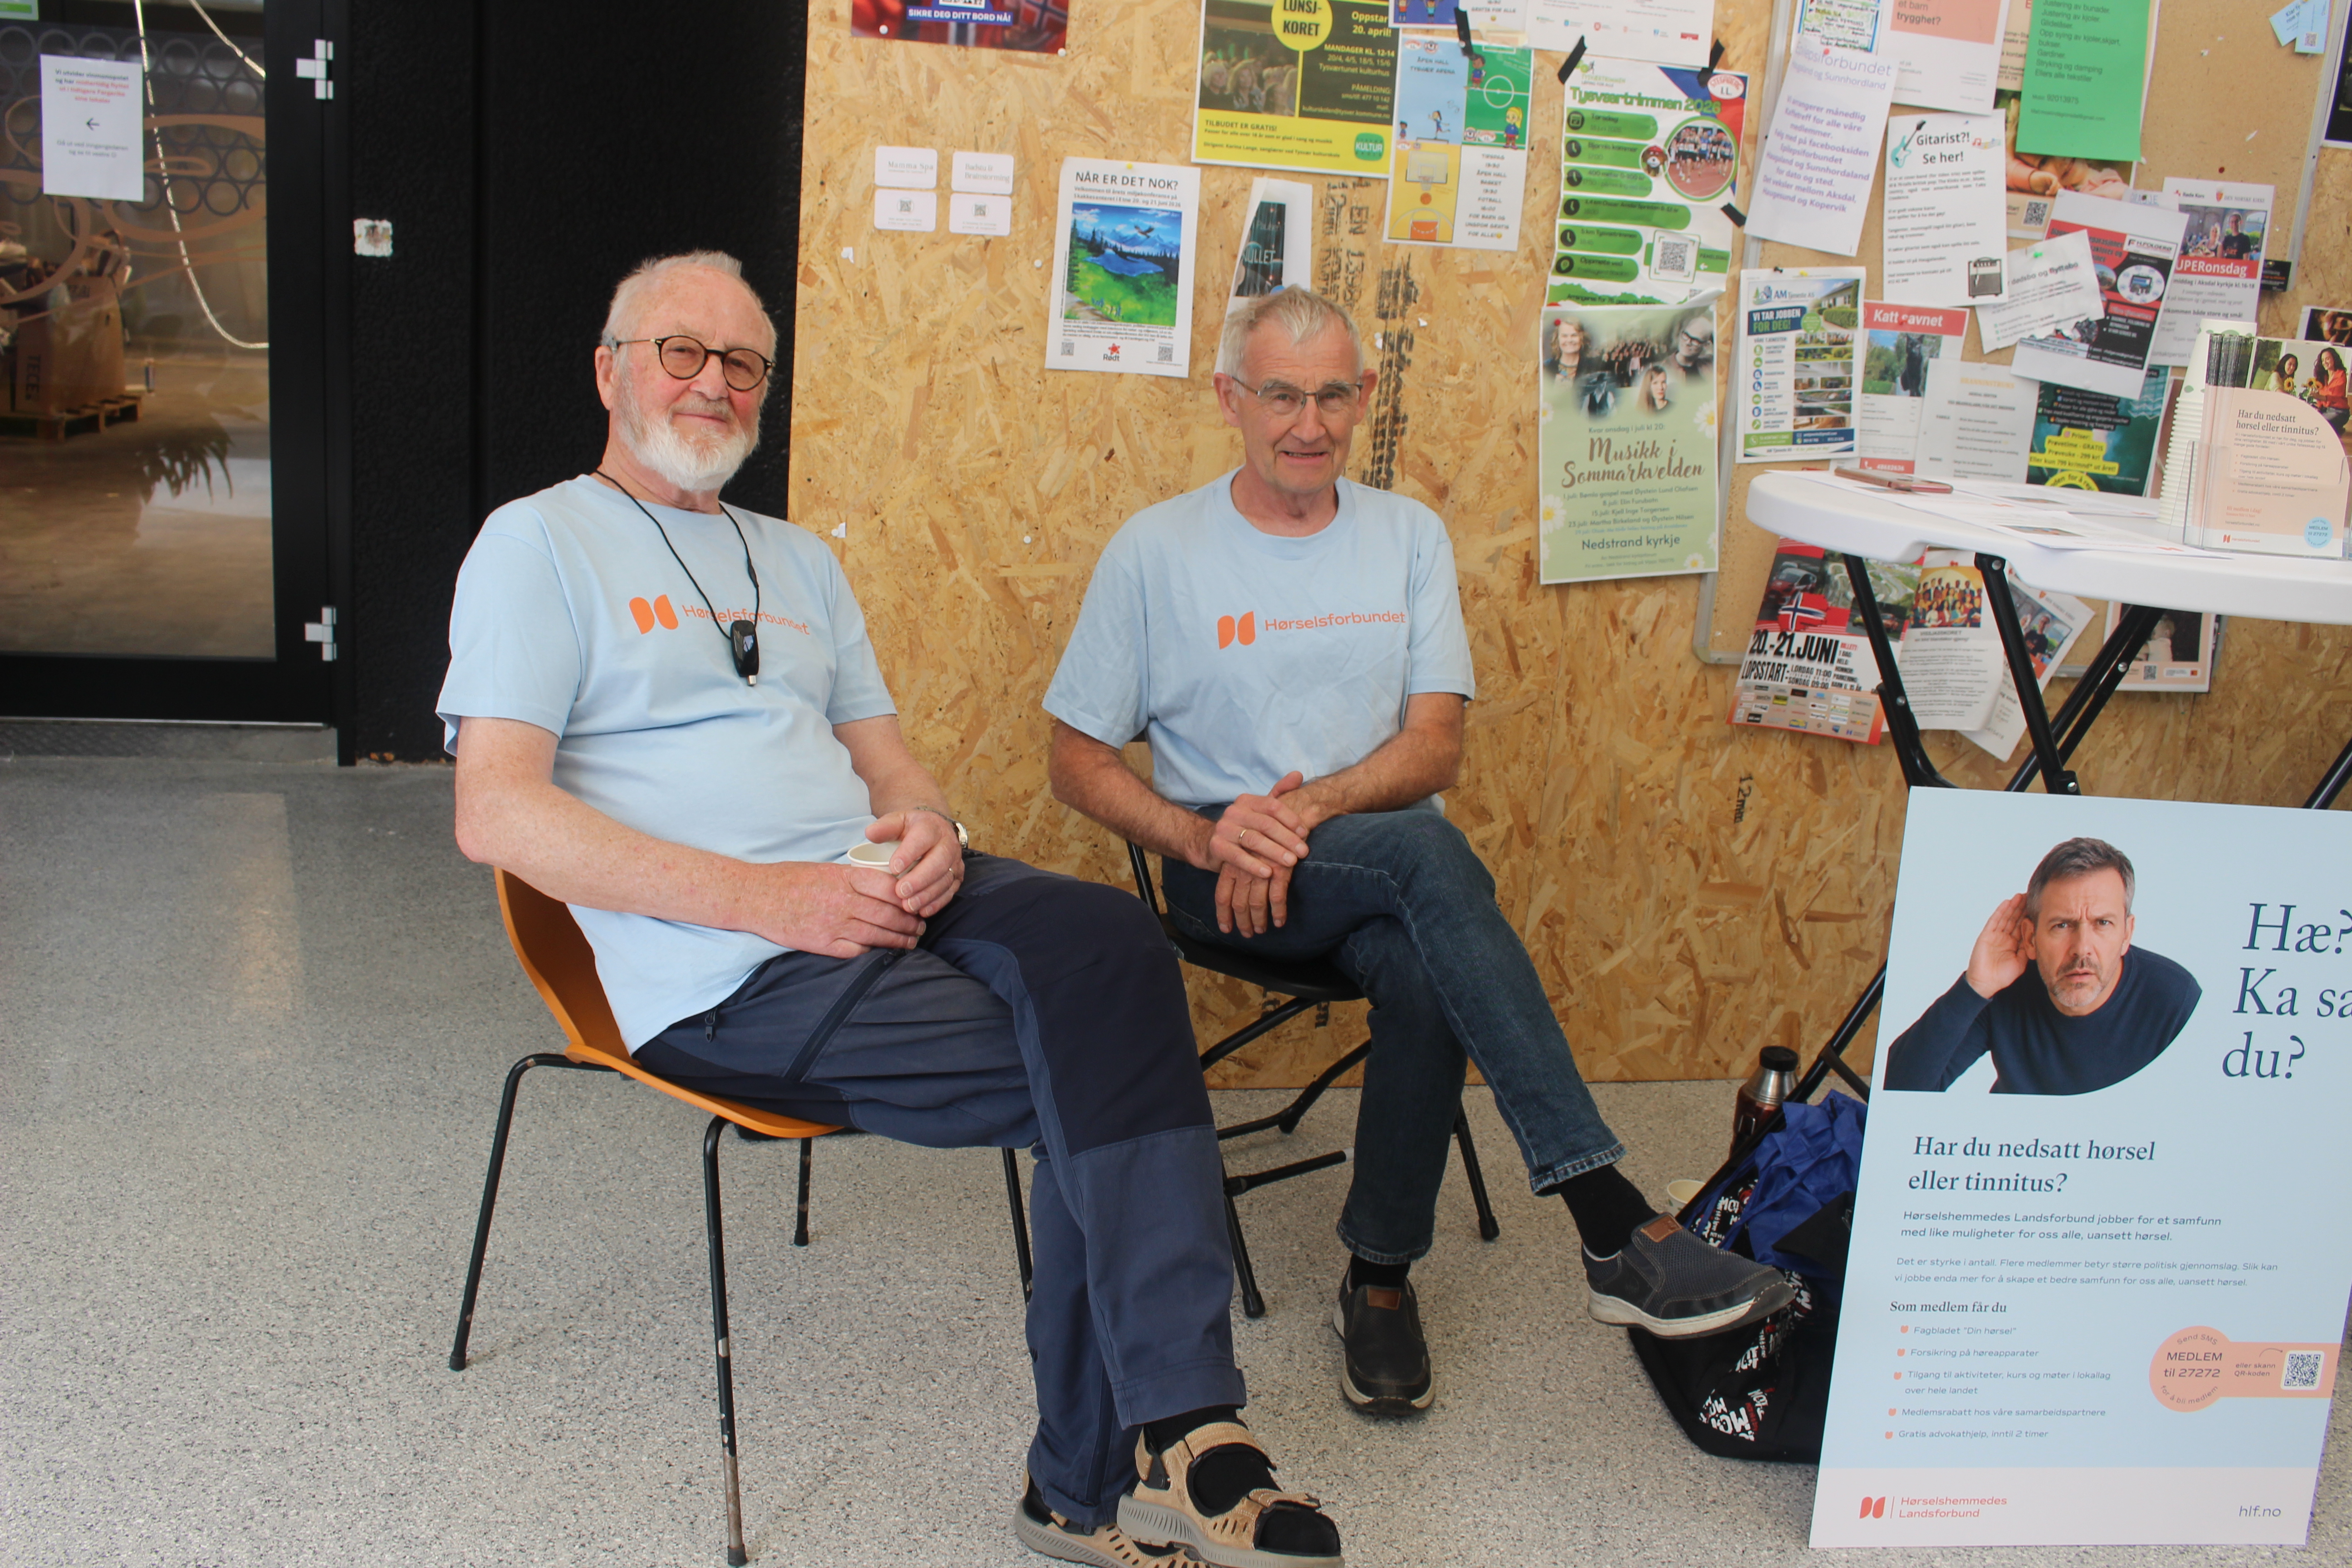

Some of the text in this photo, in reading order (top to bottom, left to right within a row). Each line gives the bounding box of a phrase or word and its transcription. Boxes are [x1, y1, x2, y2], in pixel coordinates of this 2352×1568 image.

[908, 8, 1011, 22] SIKRE DEG DITT BORD NÅ!
[1352, 11, 1388, 23] Oppstar
[1897, 12, 1941, 25] trygghet?
[1283, 20, 1320, 36] KORET
[1352, 24, 1392, 38] 20. april!
[1324, 44, 1364, 55] MANDAGER
[1377, 49, 1396, 58] 12-14
[2036, 59, 2063, 70] Stryking
[1684, 98, 1722, 115] 2026
[1205, 119, 1238, 128] TILBUDET
[1916, 132, 1970, 146] Gitarist?!
[1355, 142, 1383, 152] KULTUR
[1923, 152, 1964, 164] Se her!
[1076, 171, 1179, 191] NÅR ER DET NOK?
[1774, 290, 1788, 299] AM
[1752, 309, 1801, 322] VI TAR JOBBEN
[1873, 309, 1899, 323] Katt
[1753, 319, 1792, 333] FOR DEG!
[1103, 353, 1120, 362] Rødt
[2238, 409, 2296, 423] Har du nedsatt
[2261, 423, 2280, 433] eller
[2281, 425, 2319, 436] tinnitus?
[1589, 437, 1679, 465] Musikk i
[1562, 456, 1705, 488] Sommarkvelden
[1581, 534, 1681, 550] Nedstrand kyrkje
[1264, 611, 1405, 631] Hørselsforbundet
[2242, 903, 2352, 955] Hæ?
[2232, 967, 2298, 1016] Ka
[2222, 1031, 2305, 1079] du?
[1914, 1136, 2155, 1161] Har du nedsatt hørsel
[1908, 1170, 2068, 1192] eller tinnitus?
[1903, 1211, 2221, 1225] Hørselshemmedes Landsforbund jobber for et samfunn
[1901, 1227, 1926, 1237] med
[1929, 1228, 1950, 1237] like
[1952, 1228, 2015, 1240] muligheter
[2018, 1229, 2036, 1239] for
[2061, 1230, 2083, 1240] alle,
[2087, 1231, 2132, 1240] uansett
[2134, 1231, 2172, 1241] hørsel.
[1890, 1301, 2007, 1313] Som medlem får du
[1913, 1326, 1961, 1336] Fagbladet
[1963, 1327, 1982, 1335] "Din
[2177, 1334, 2218, 1345] Send SMS
[1910, 1348, 2039, 1358] Forsikring på høreapparater
[2166, 1352, 2223, 1361] MEDLEM
[1907, 1370, 1940, 1380] Tilgang
[1954, 1371, 2004, 1379] aktiviteter,
[2029, 1372, 2041, 1380] og
[2077, 1371, 2111, 1381] lokallag
[2164, 1368, 2220, 1377] til 27272
[2161, 1385, 2170, 1396] for
[2188, 1385, 2218, 1404] medlem
[1901, 1408, 1972, 1416] Medlemsrabatt
[1993, 1408, 2013, 1416] våre
[2015, 1408, 2106, 1417] samarbeidspartnere
[1898, 1430, 1926, 1438] Gratis
[1928, 1430, 1989, 1439] advokathjelp,
[1901, 1496, 2007, 1506] Hørselshemmedes
[1899, 1509, 1980, 1518] Landsforbund
[2239, 1505, 2281, 1517] hlf.no
